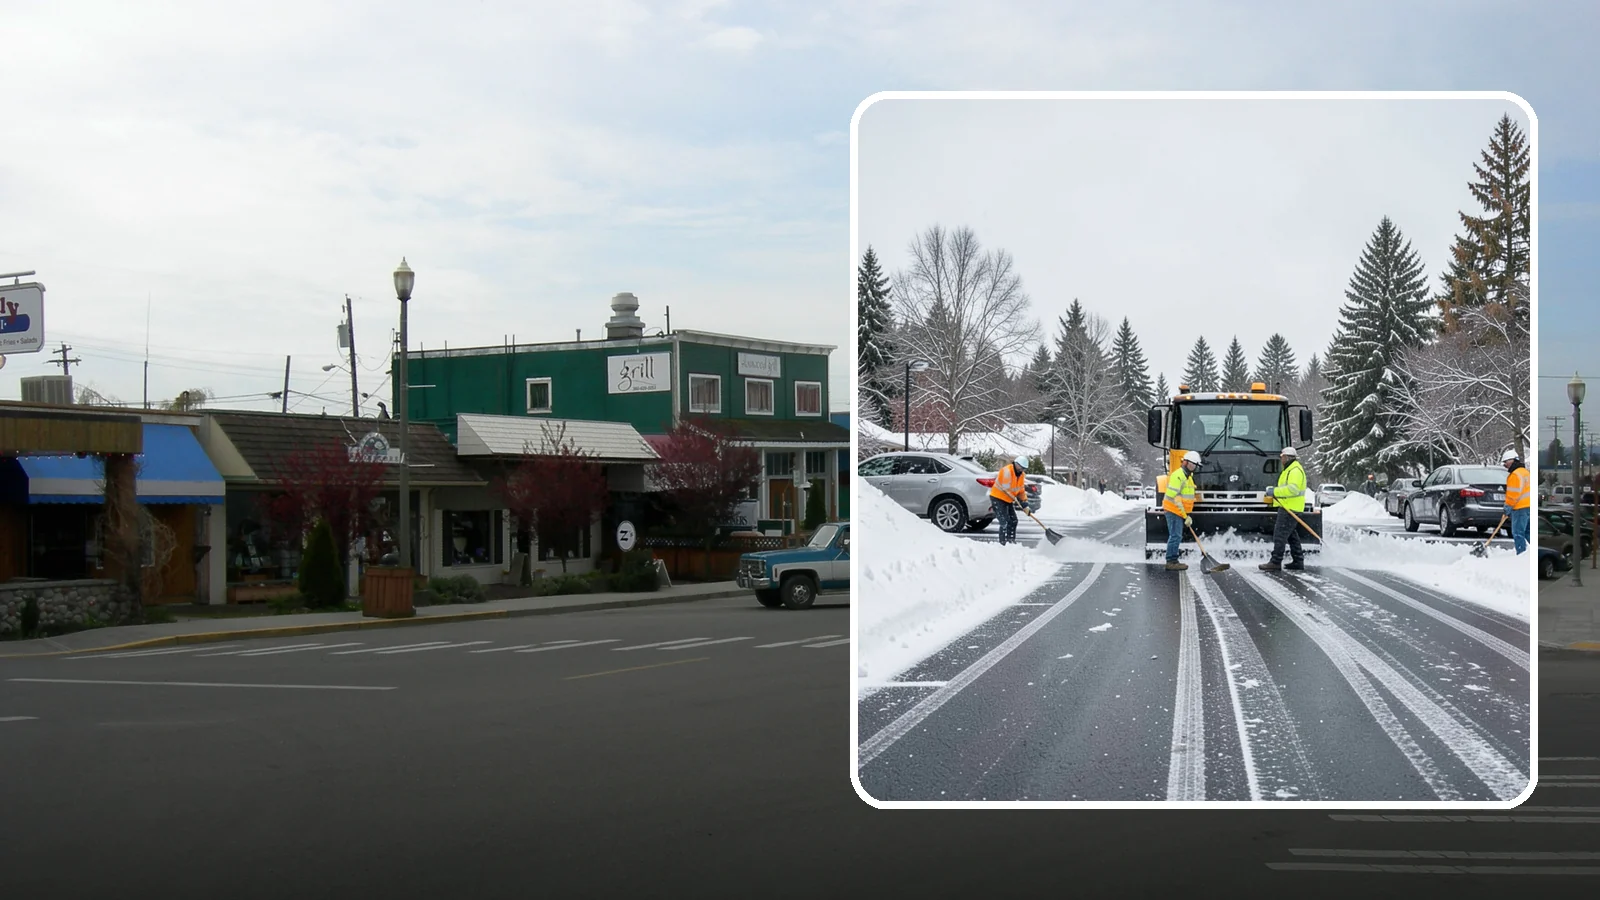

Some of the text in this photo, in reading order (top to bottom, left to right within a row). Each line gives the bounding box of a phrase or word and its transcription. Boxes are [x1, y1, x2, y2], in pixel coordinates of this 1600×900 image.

[3, 338, 16, 346] Fries
[20, 336, 38, 345] Salads
[617, 355, 655, 391] grill
